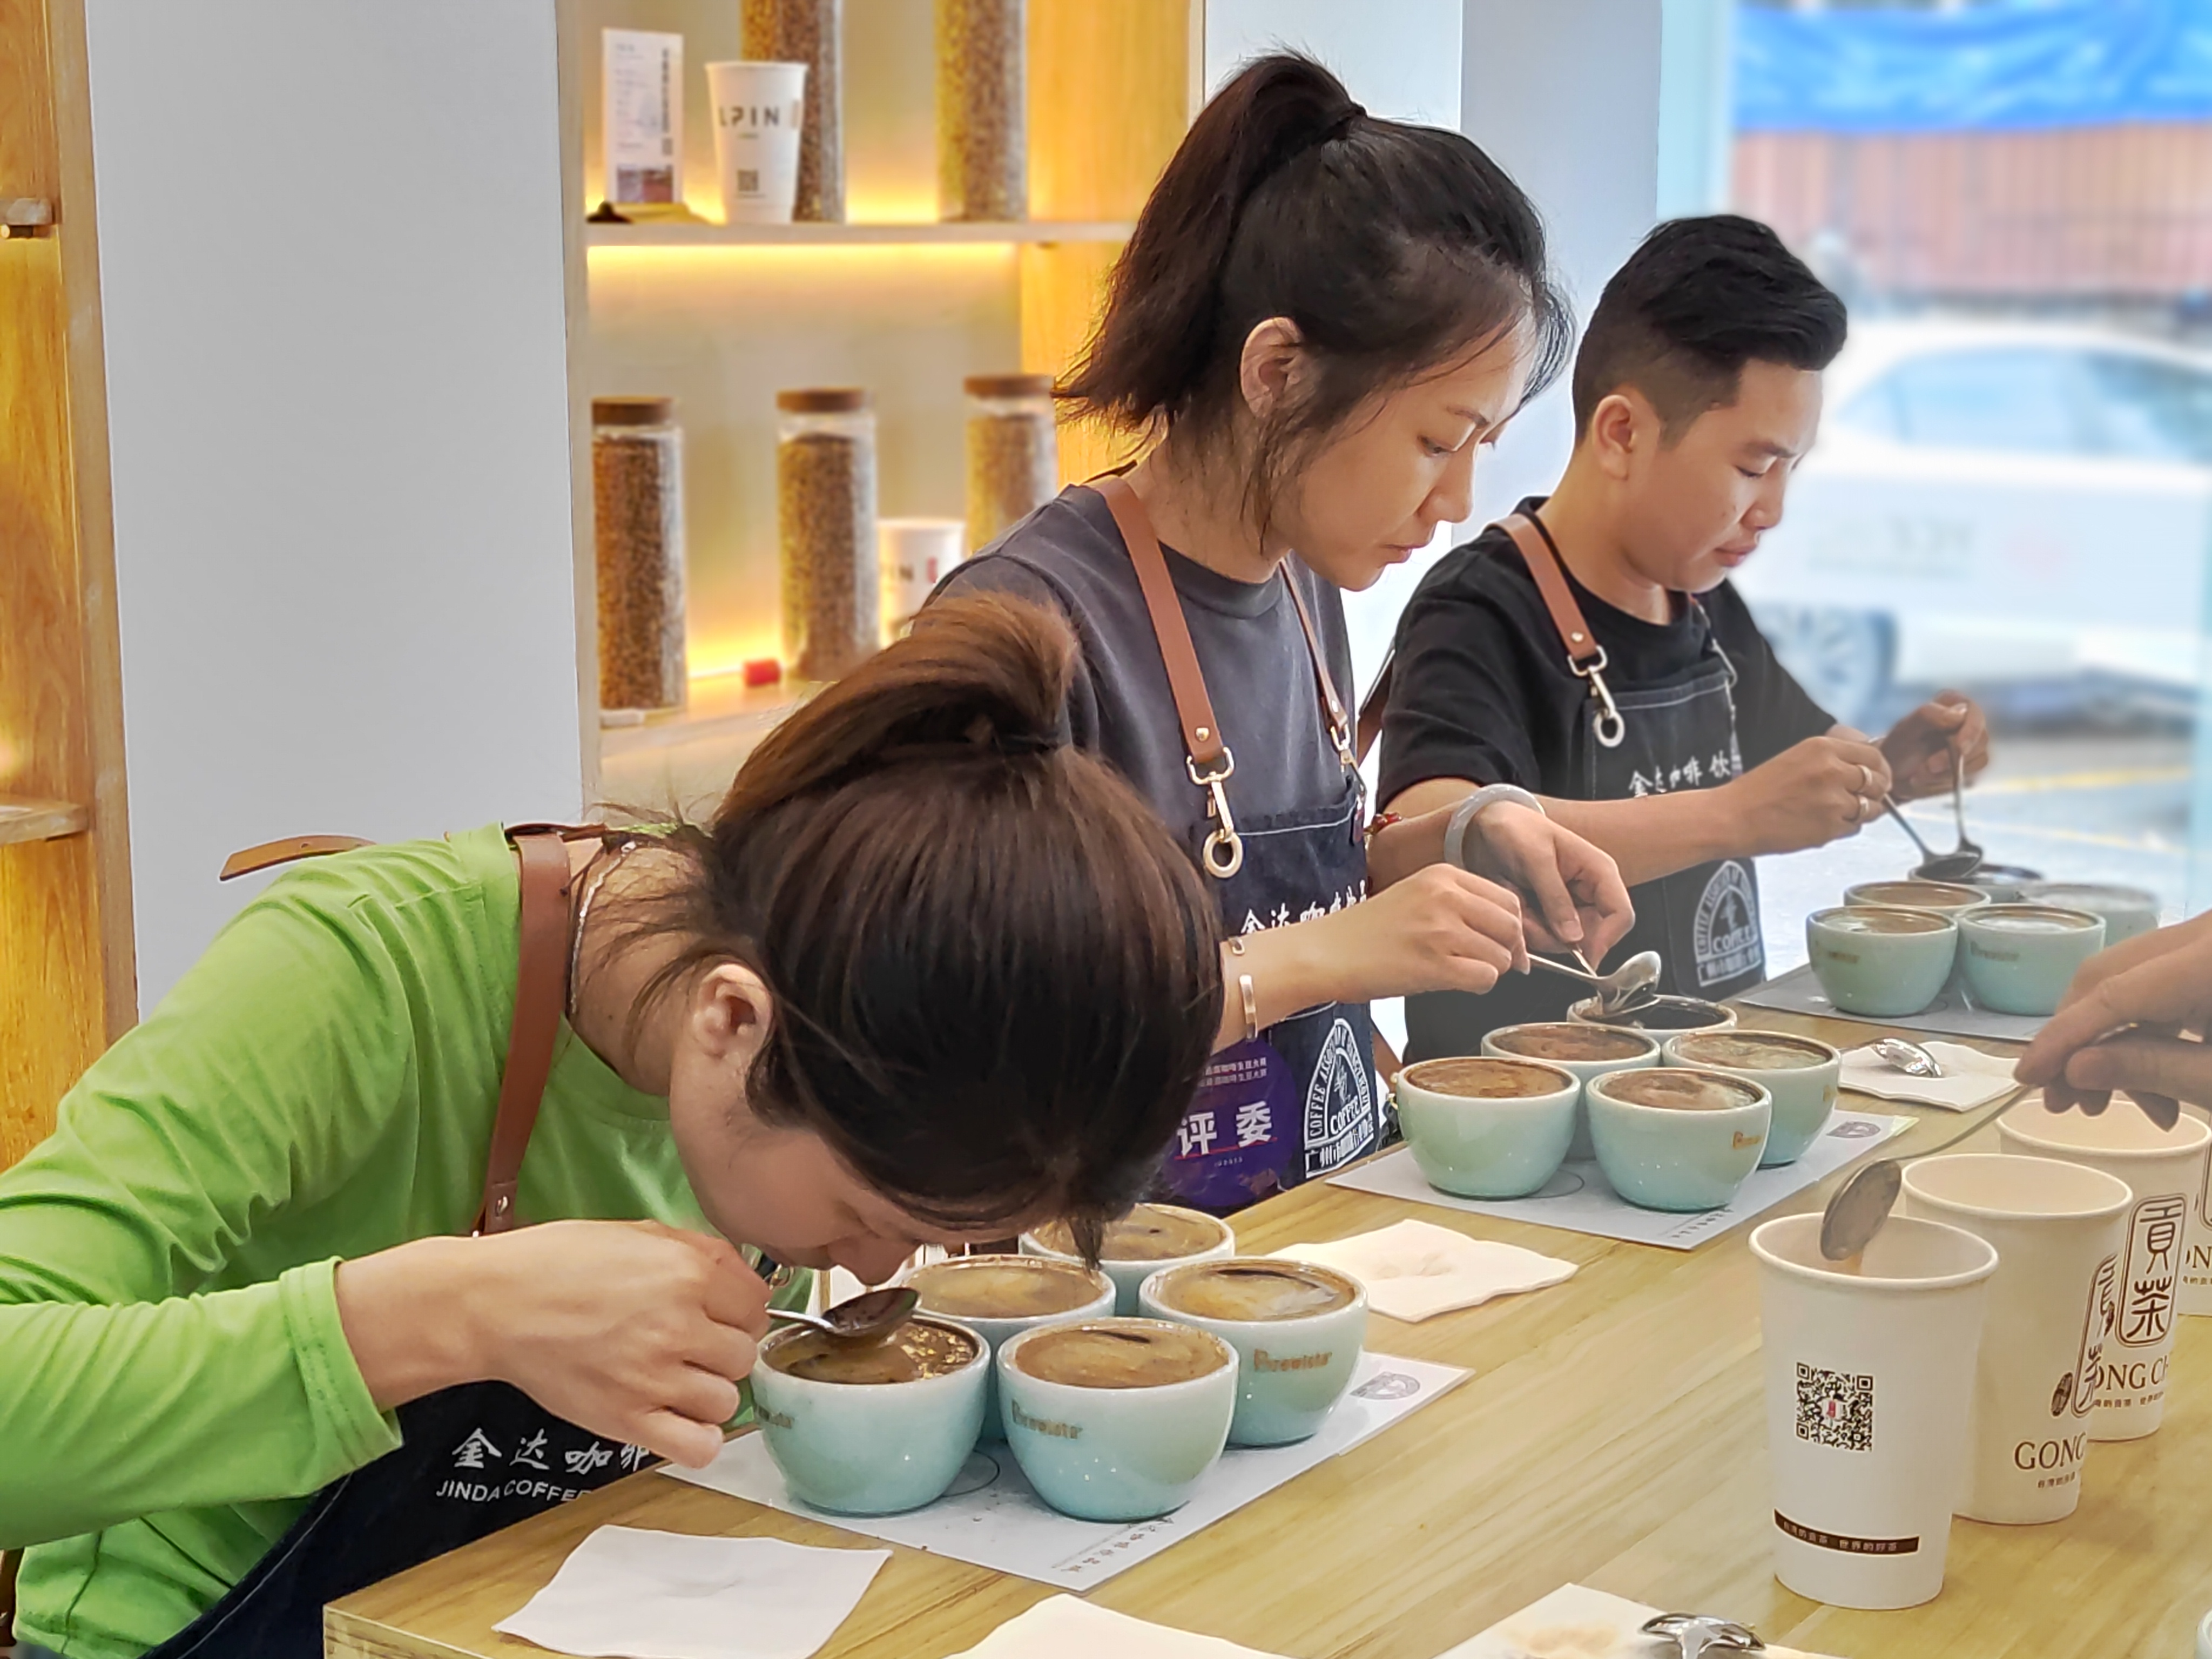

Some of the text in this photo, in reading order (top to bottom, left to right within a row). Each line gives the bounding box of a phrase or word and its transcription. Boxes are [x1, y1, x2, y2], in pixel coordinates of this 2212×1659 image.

[1177, 1101, 1272, 1158] 评委
[1310, 1083, 1325, 1137] COFFEE
[436, 1479, 500, 1502] JINDA
